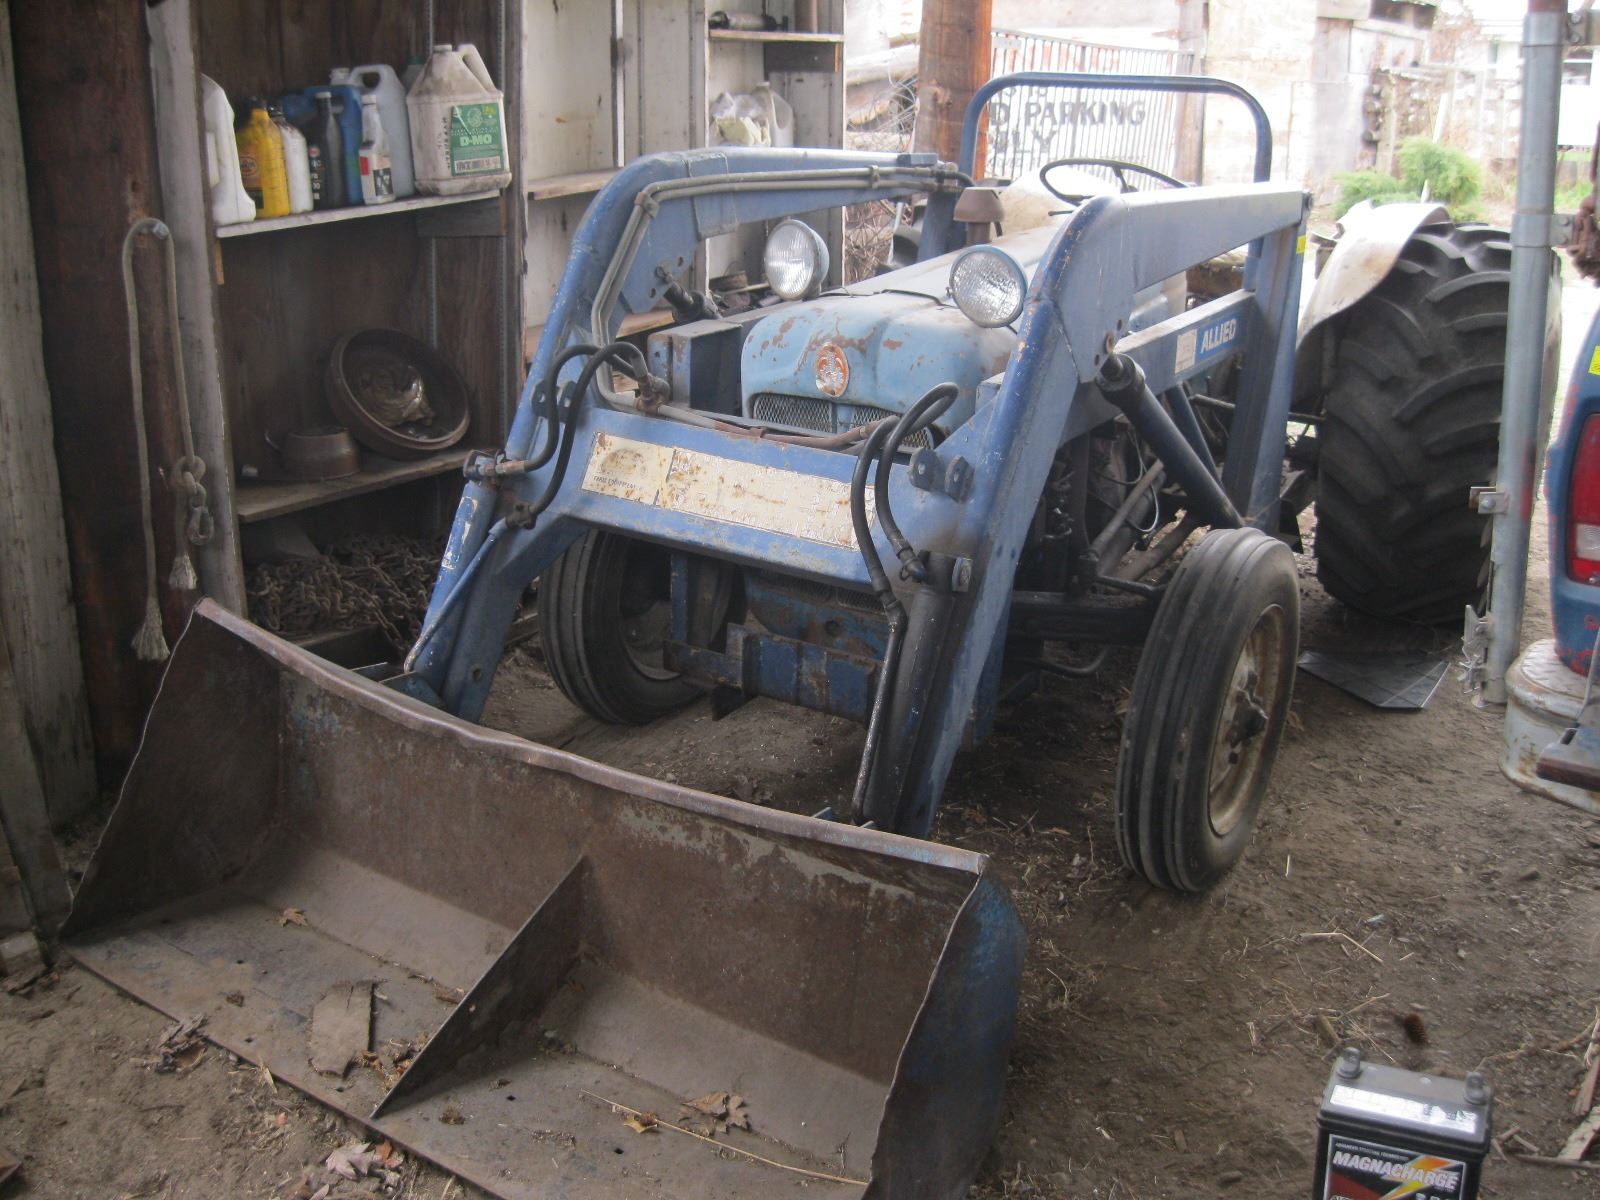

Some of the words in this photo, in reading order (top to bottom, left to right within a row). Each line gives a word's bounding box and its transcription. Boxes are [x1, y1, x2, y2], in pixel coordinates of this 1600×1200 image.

[1025, 101, 1146, 126] PARKING
[1200, 318, 1237, 354] ALLIED
[1332, 1150, 1460, 1190] MAGNACHARGE
